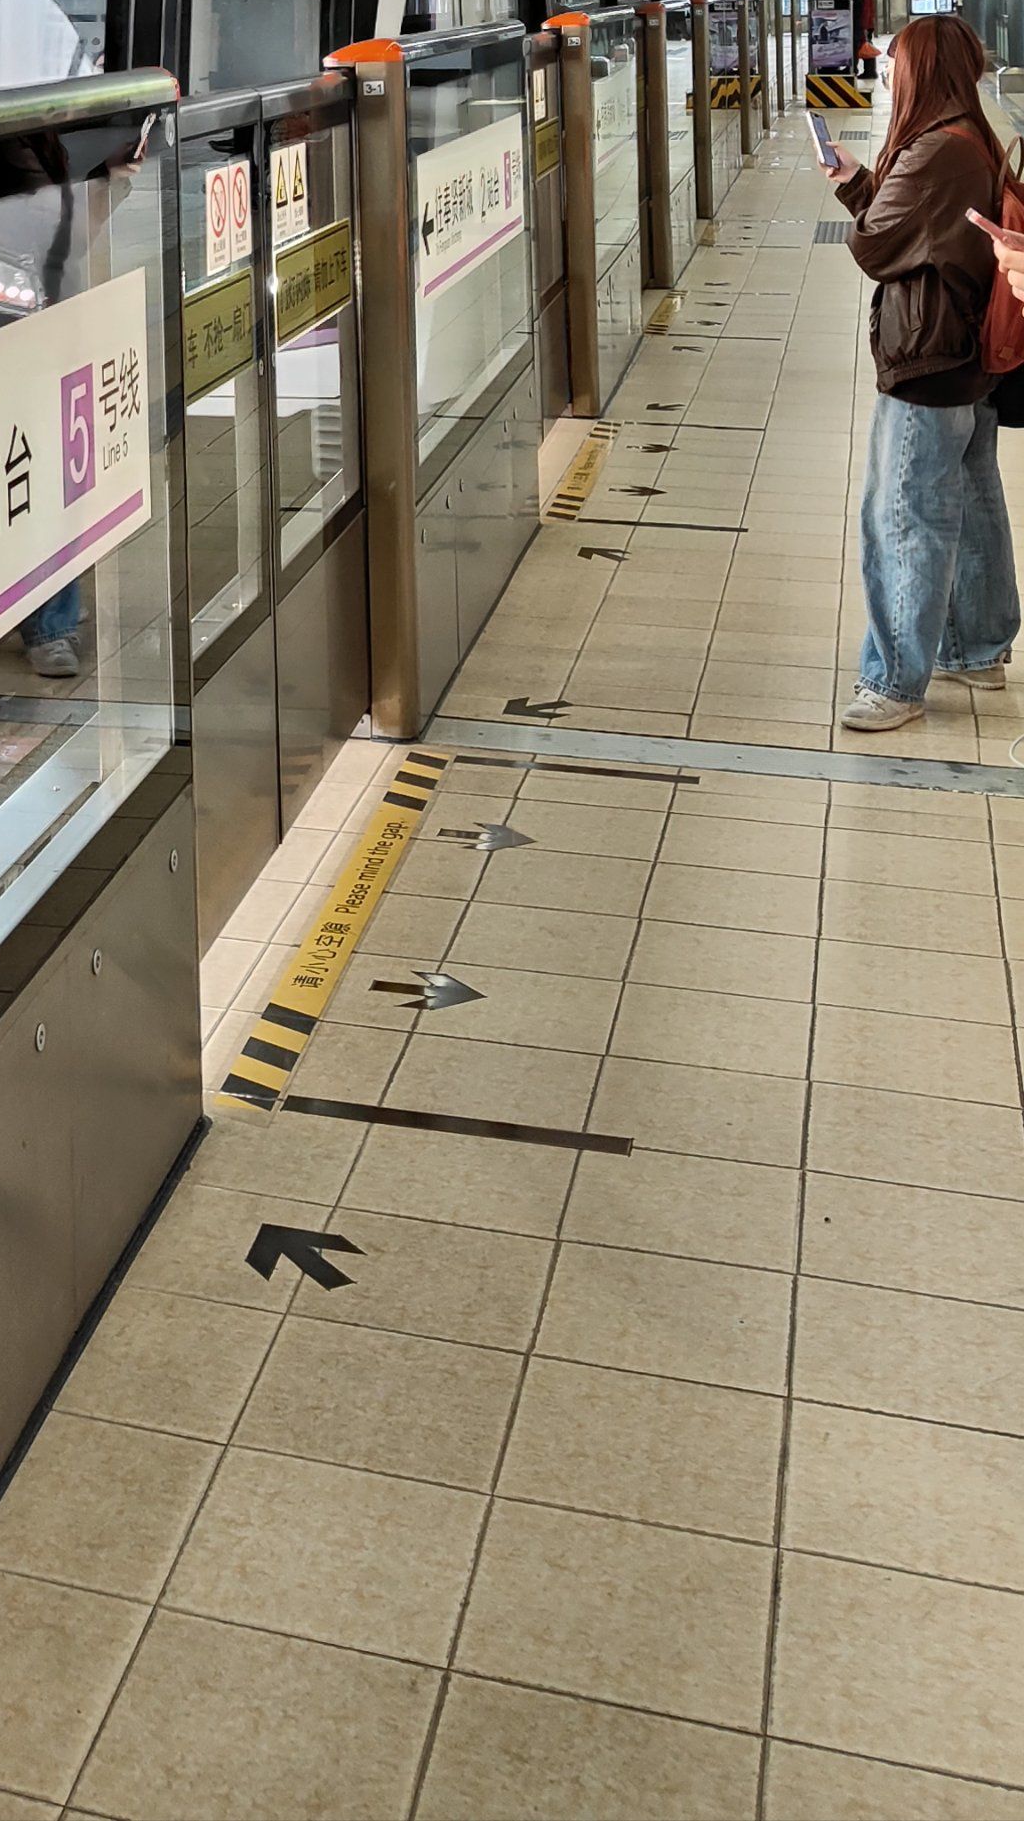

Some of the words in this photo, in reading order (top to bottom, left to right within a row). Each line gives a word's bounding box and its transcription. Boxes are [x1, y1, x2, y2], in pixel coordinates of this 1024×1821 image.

[365, 83, 382, 94] 3-1
[103, 444, 121, 470] Line
[122, 432, 129, 457] 5
[367, 840, 394, 858] the
[356, 856, 385, 882] mind
[334, 883, 371, 915] Please
[291, 921, 352, 988] 请小心空隙
